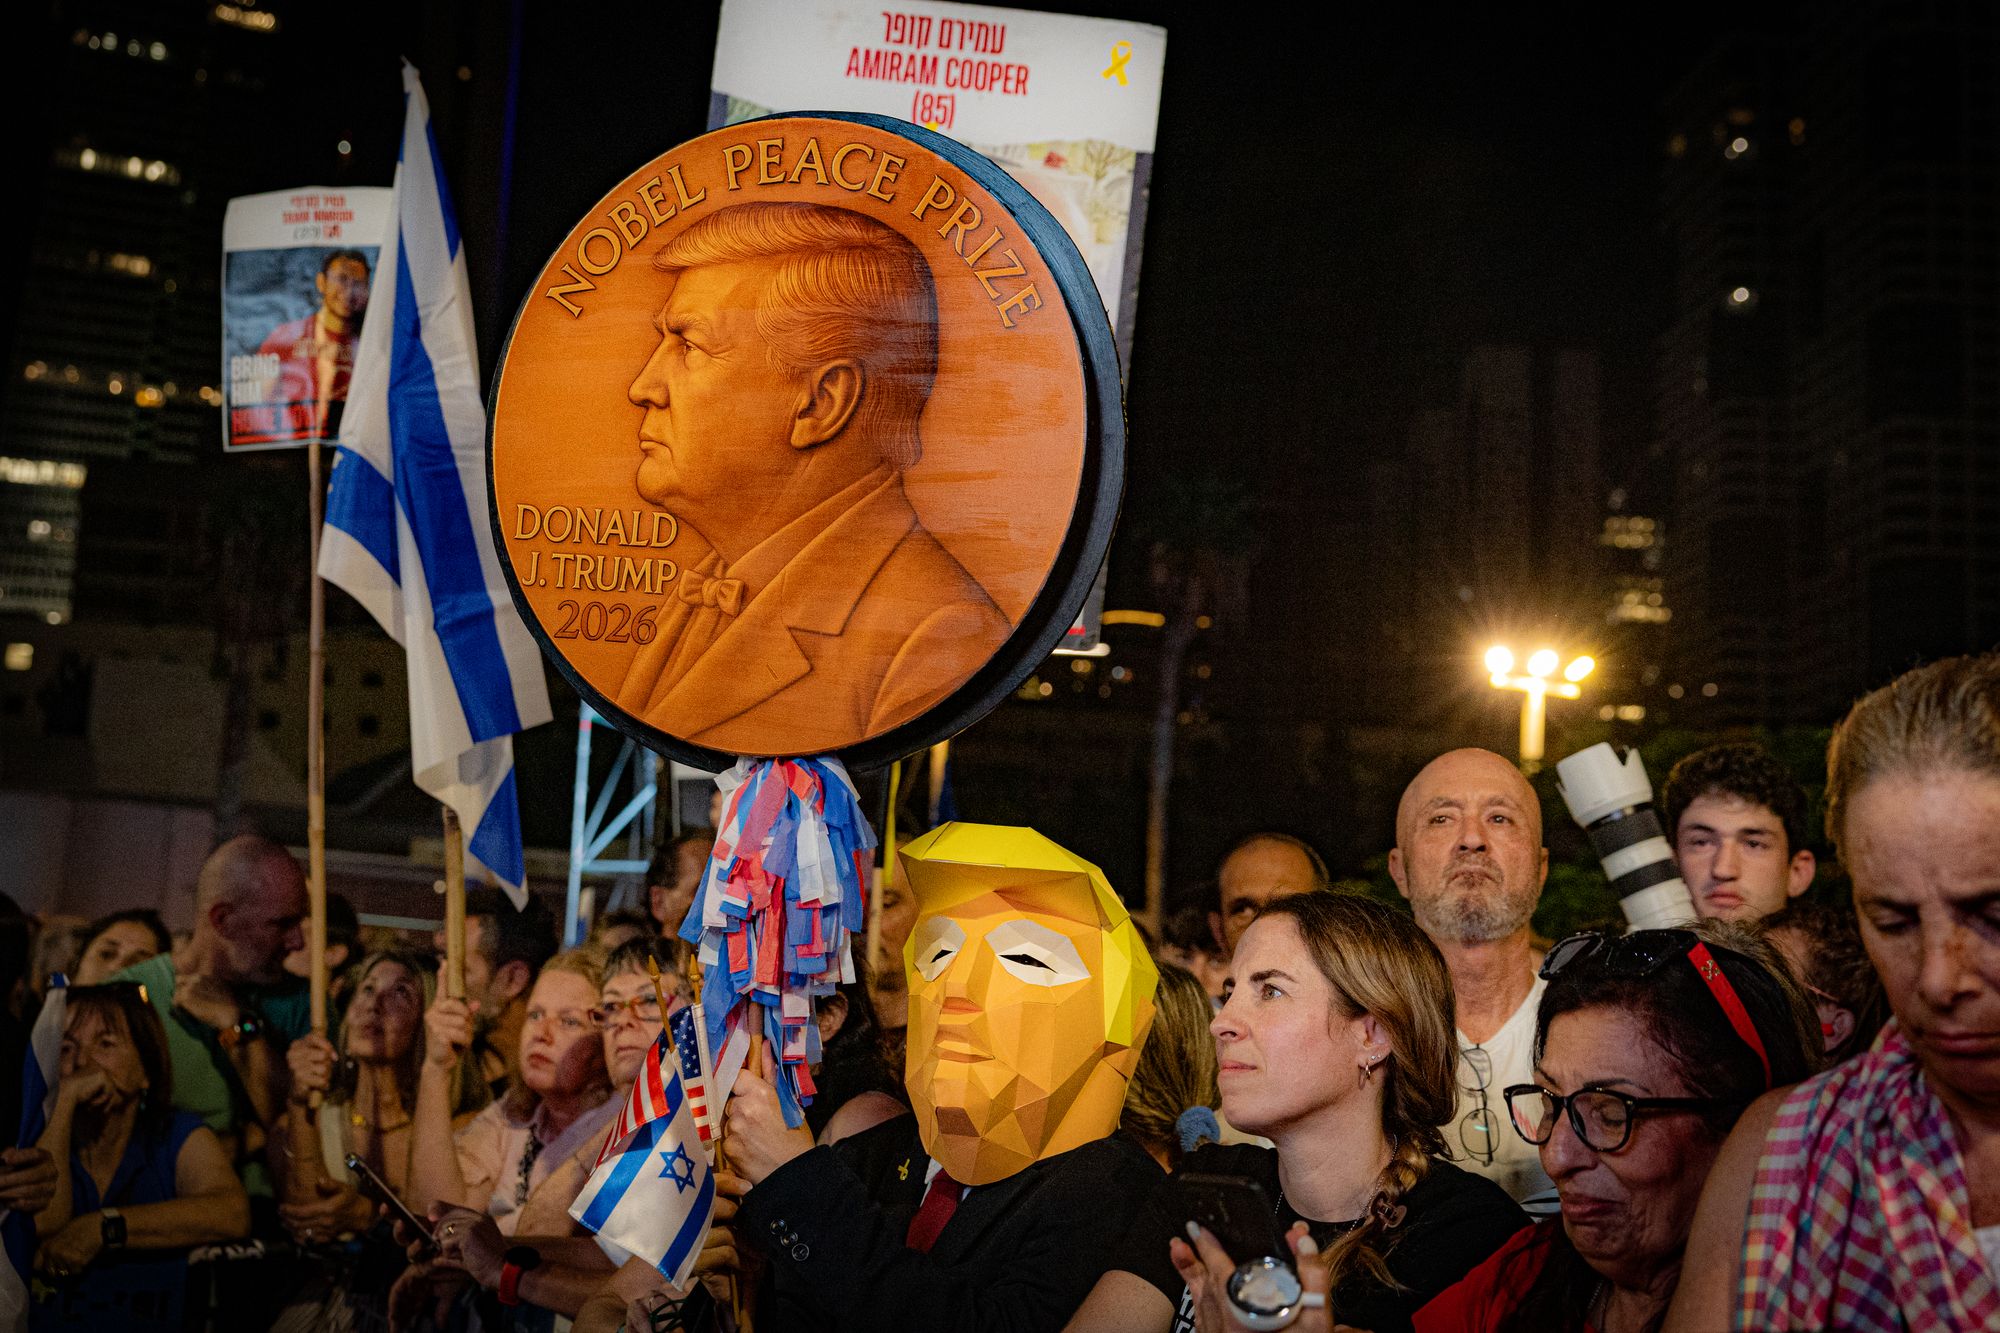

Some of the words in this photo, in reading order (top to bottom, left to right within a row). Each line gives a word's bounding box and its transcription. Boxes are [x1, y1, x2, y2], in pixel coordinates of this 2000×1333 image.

[882, 12, 933, 50] קופר
[938, 16, 1007, 55] עמירם
[846, 47, 939, 86] AMIRAM
[945, 57, 1030, 96] COOPER
[911, 90, 957, 129] (85)
[546, 164, 706, 317] NOBEL
[723, 137, 906, 202] PEACE
[911, 175, 1044, 329] PRIZE
[514, 503, 679, 549] DONALD
[521, 551, 546, 587] J.
[551, 552, 679, 594] TRUMP
[553, 599, 658, 645] 2026
